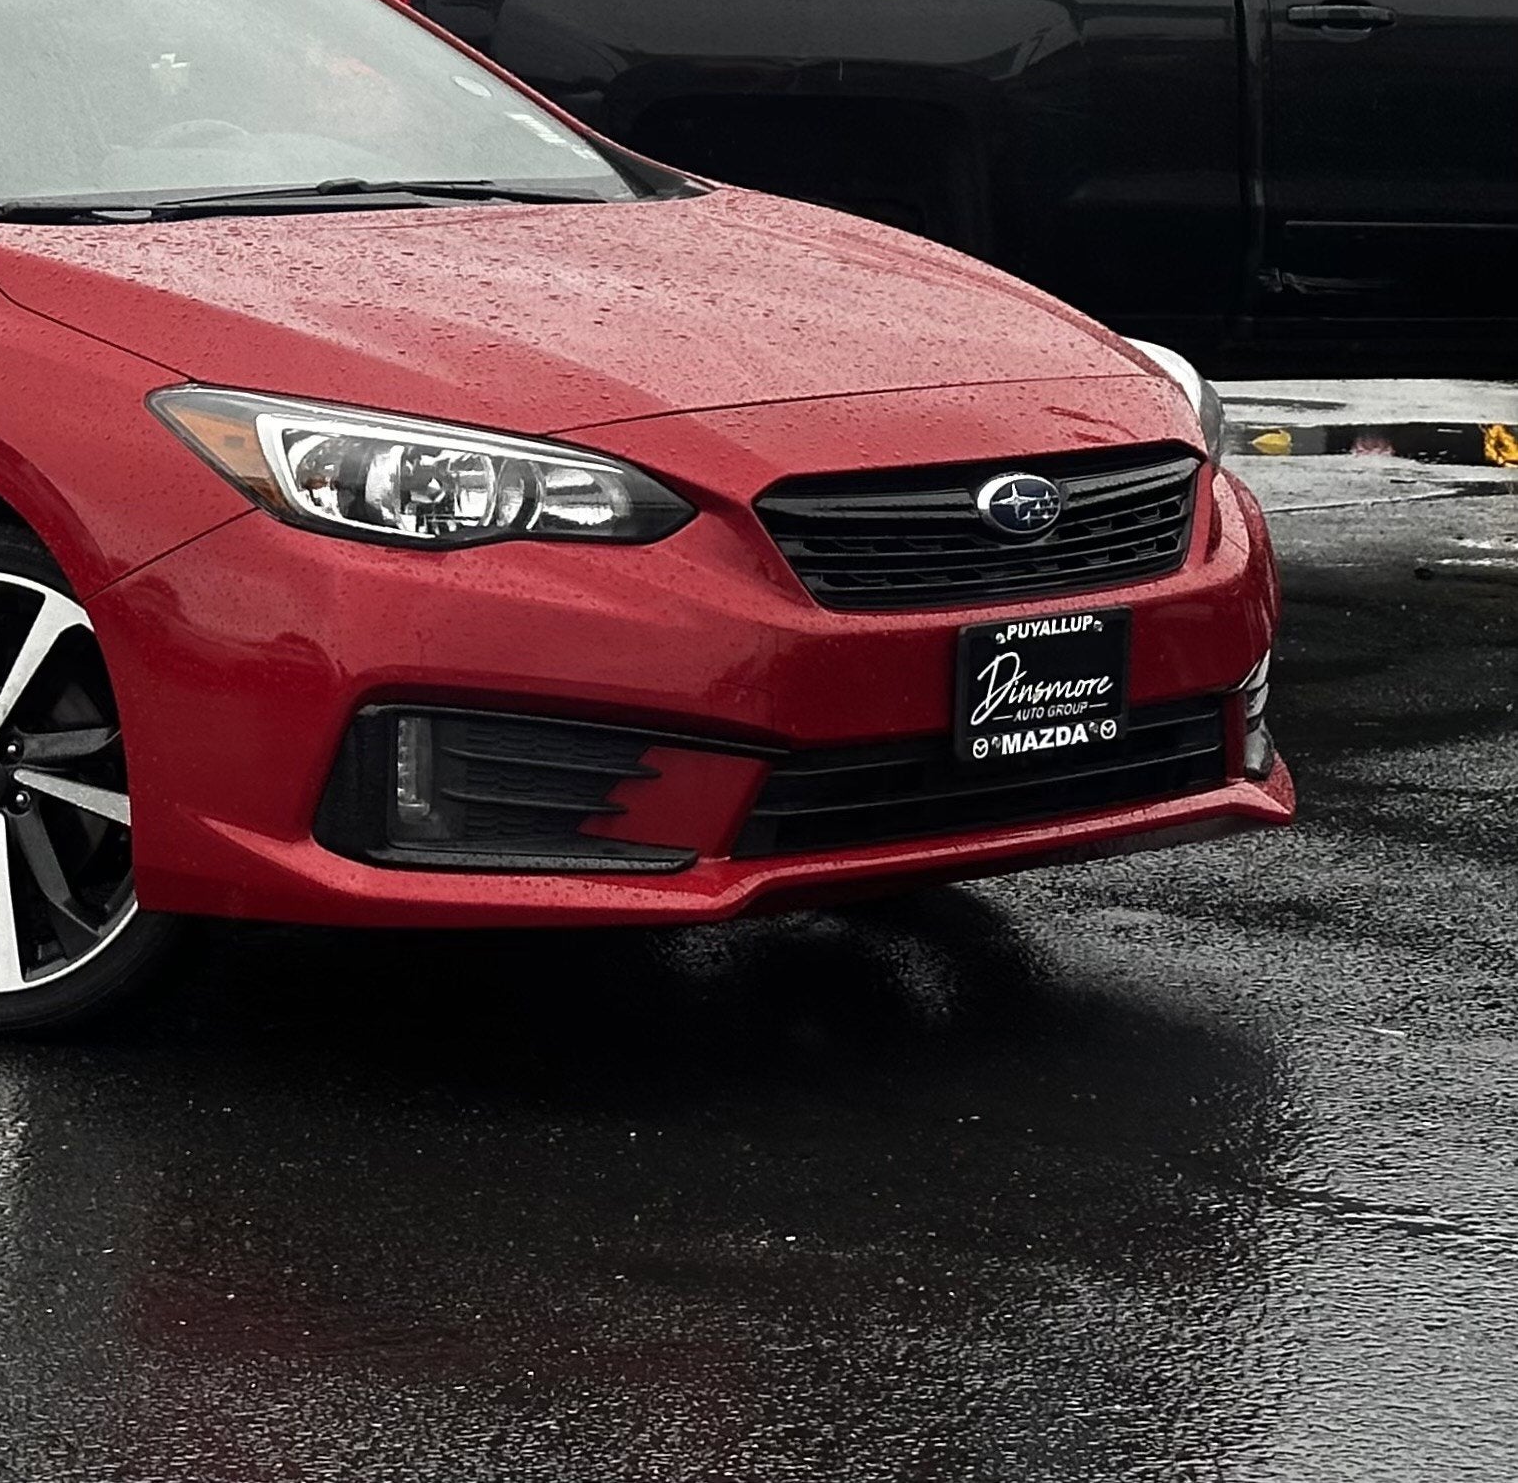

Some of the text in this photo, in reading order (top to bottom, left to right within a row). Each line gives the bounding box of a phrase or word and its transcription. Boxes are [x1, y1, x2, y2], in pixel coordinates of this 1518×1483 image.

[1006, 615, 1094, 641] PUYALLUP
[970, 651, 1114, 727] Dinsmore
[1013, 701, 1089, 723] AUTO GROUP
[1001, 723, 1090, 756] MAZDA
